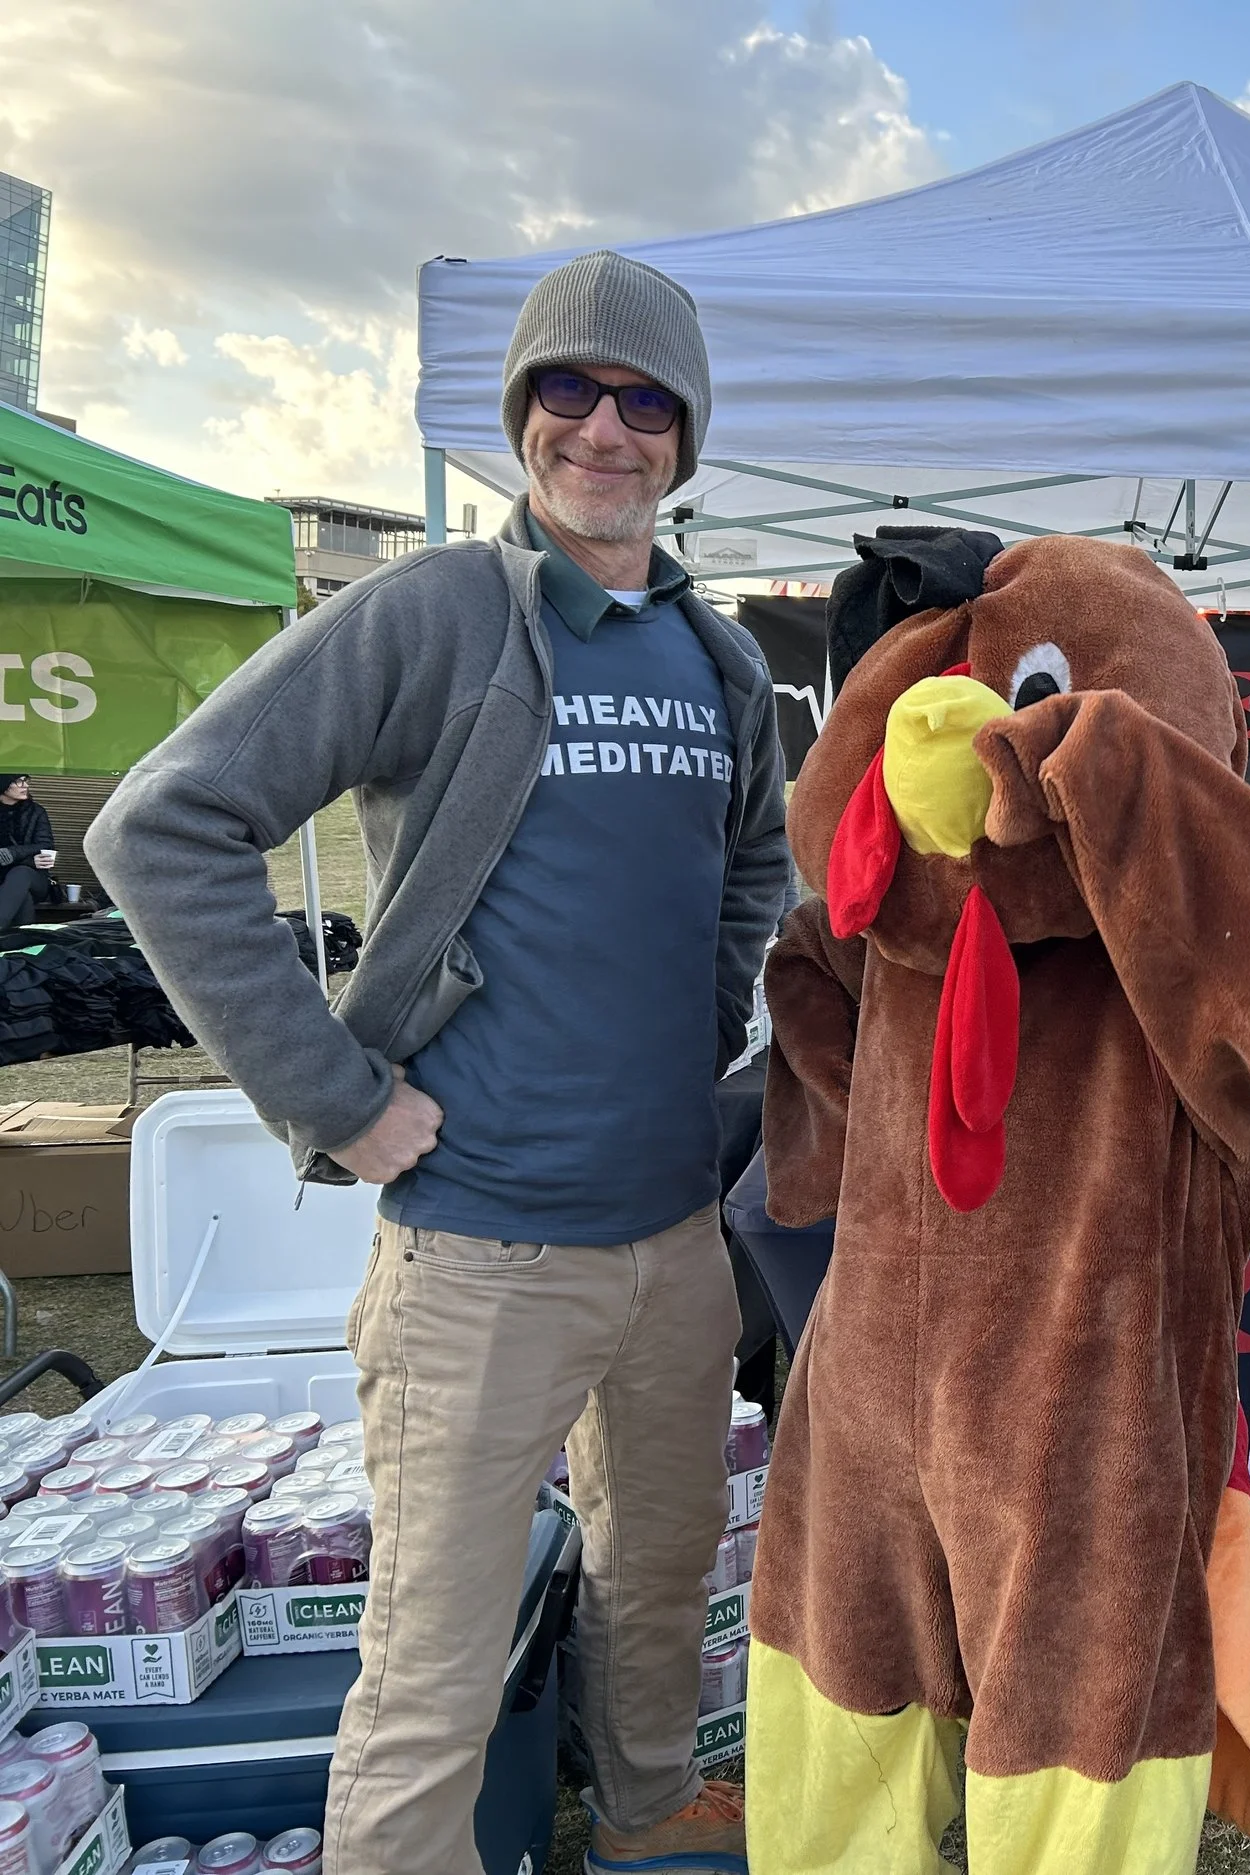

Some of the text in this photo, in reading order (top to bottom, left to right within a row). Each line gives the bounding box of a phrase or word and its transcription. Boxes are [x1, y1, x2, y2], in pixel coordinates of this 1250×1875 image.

[552, 695, 716, 735] HEAVILY
[0, 1190, 99, 1232] Uber
[102, 1580, 126, 1634] EAN
[300, 1601, 363, 1620] CLEAN
[705, 1603, 738, 1629] EAN
[283, 1630, 354, 1642] ORGANIC YERBA
[39, 1656, 104, 1676] LEAN
[51, 1692, 90, 1701] YERBA
[93, 1690, 125, 1700] MATE
[695, 1720, 741, 1750] LEAN
[702, 1751, 730, 1766] YERBA
